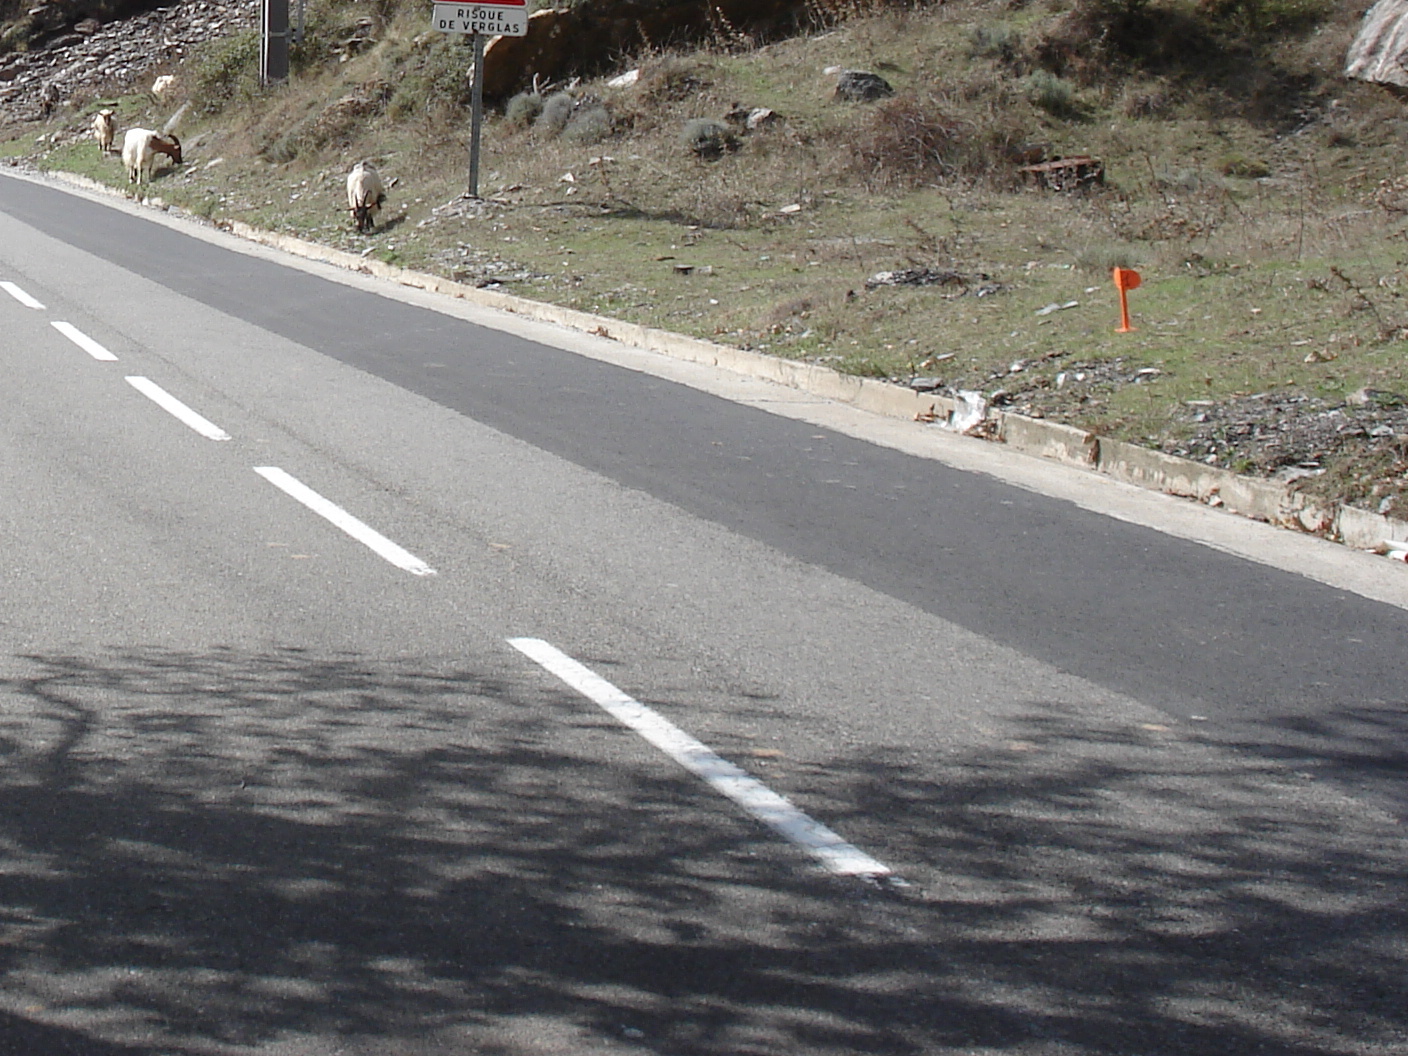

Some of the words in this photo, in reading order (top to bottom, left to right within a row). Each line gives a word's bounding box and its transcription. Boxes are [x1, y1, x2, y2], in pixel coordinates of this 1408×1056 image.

[457, 9, 504, 21] RISQUE
[439, 19, 455, 30] DE
[462, 21, 520, 33] VERGLAS
